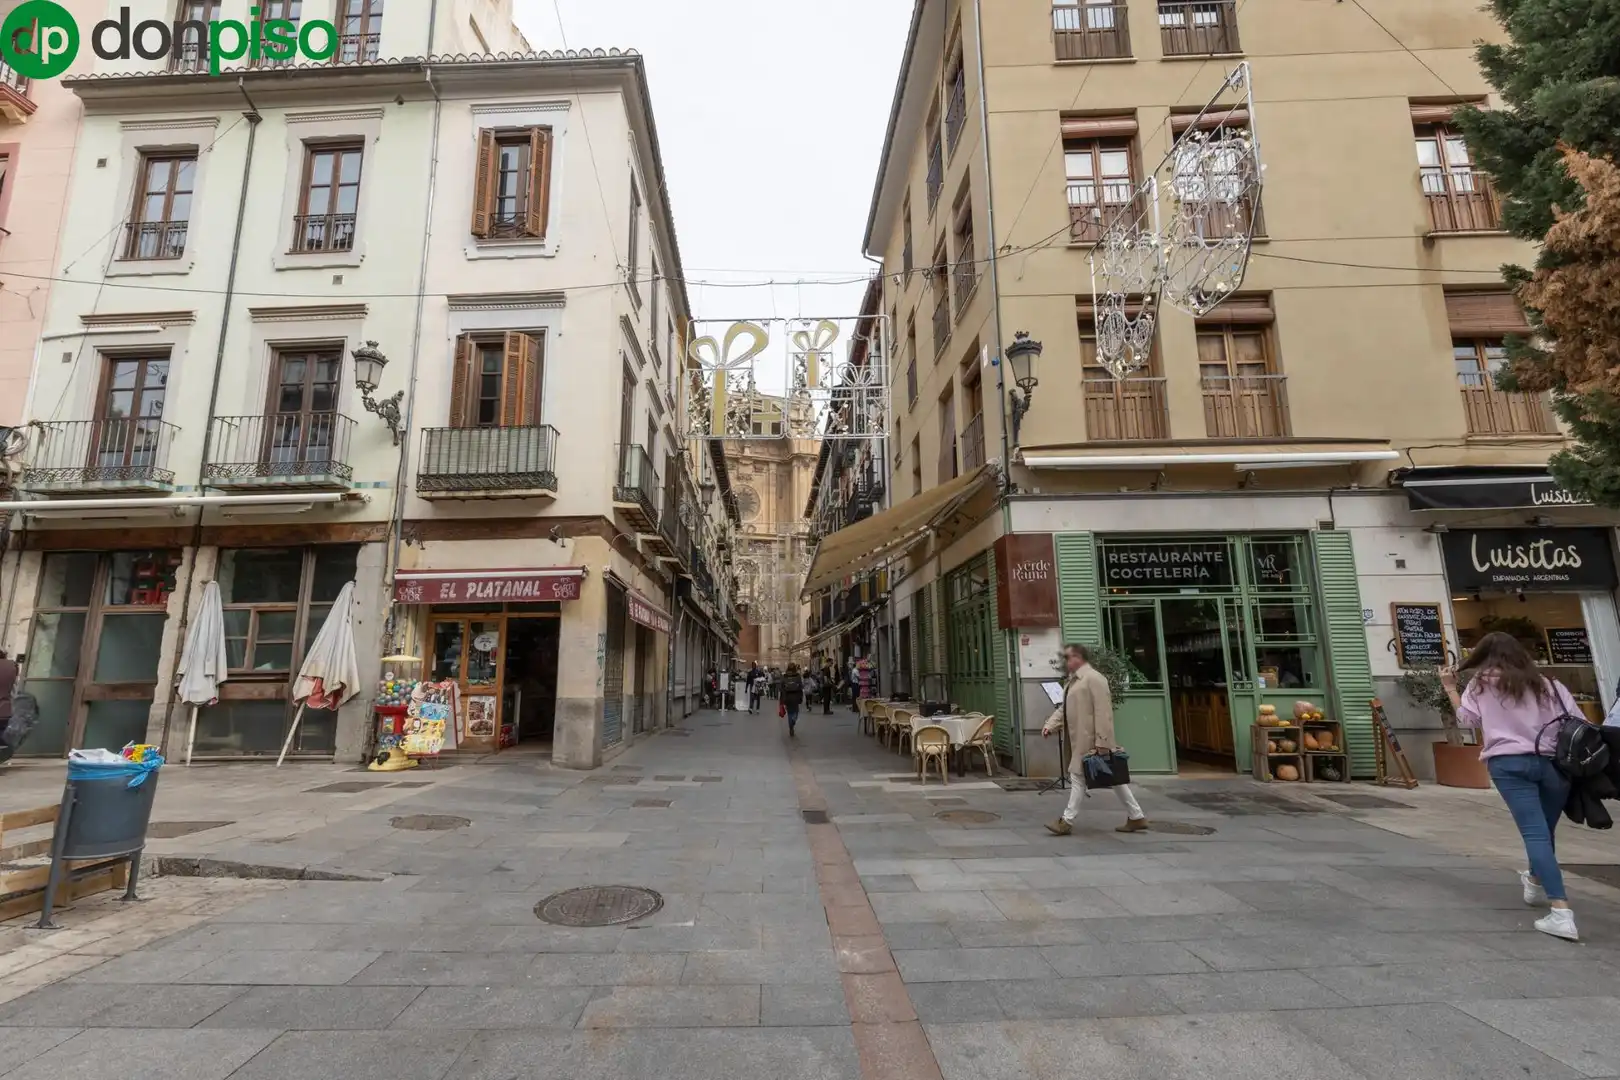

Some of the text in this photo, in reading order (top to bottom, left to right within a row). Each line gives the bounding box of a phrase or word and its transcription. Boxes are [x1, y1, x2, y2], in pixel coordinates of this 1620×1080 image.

[1109, 551, 1224, 563] RESTAURANTE
[1471, 533, 1582, 572] Luisitas
[1110, 564, 1210, 579] COCTELERÍA
[440, 580, 540, 600] EL PLATANAL
